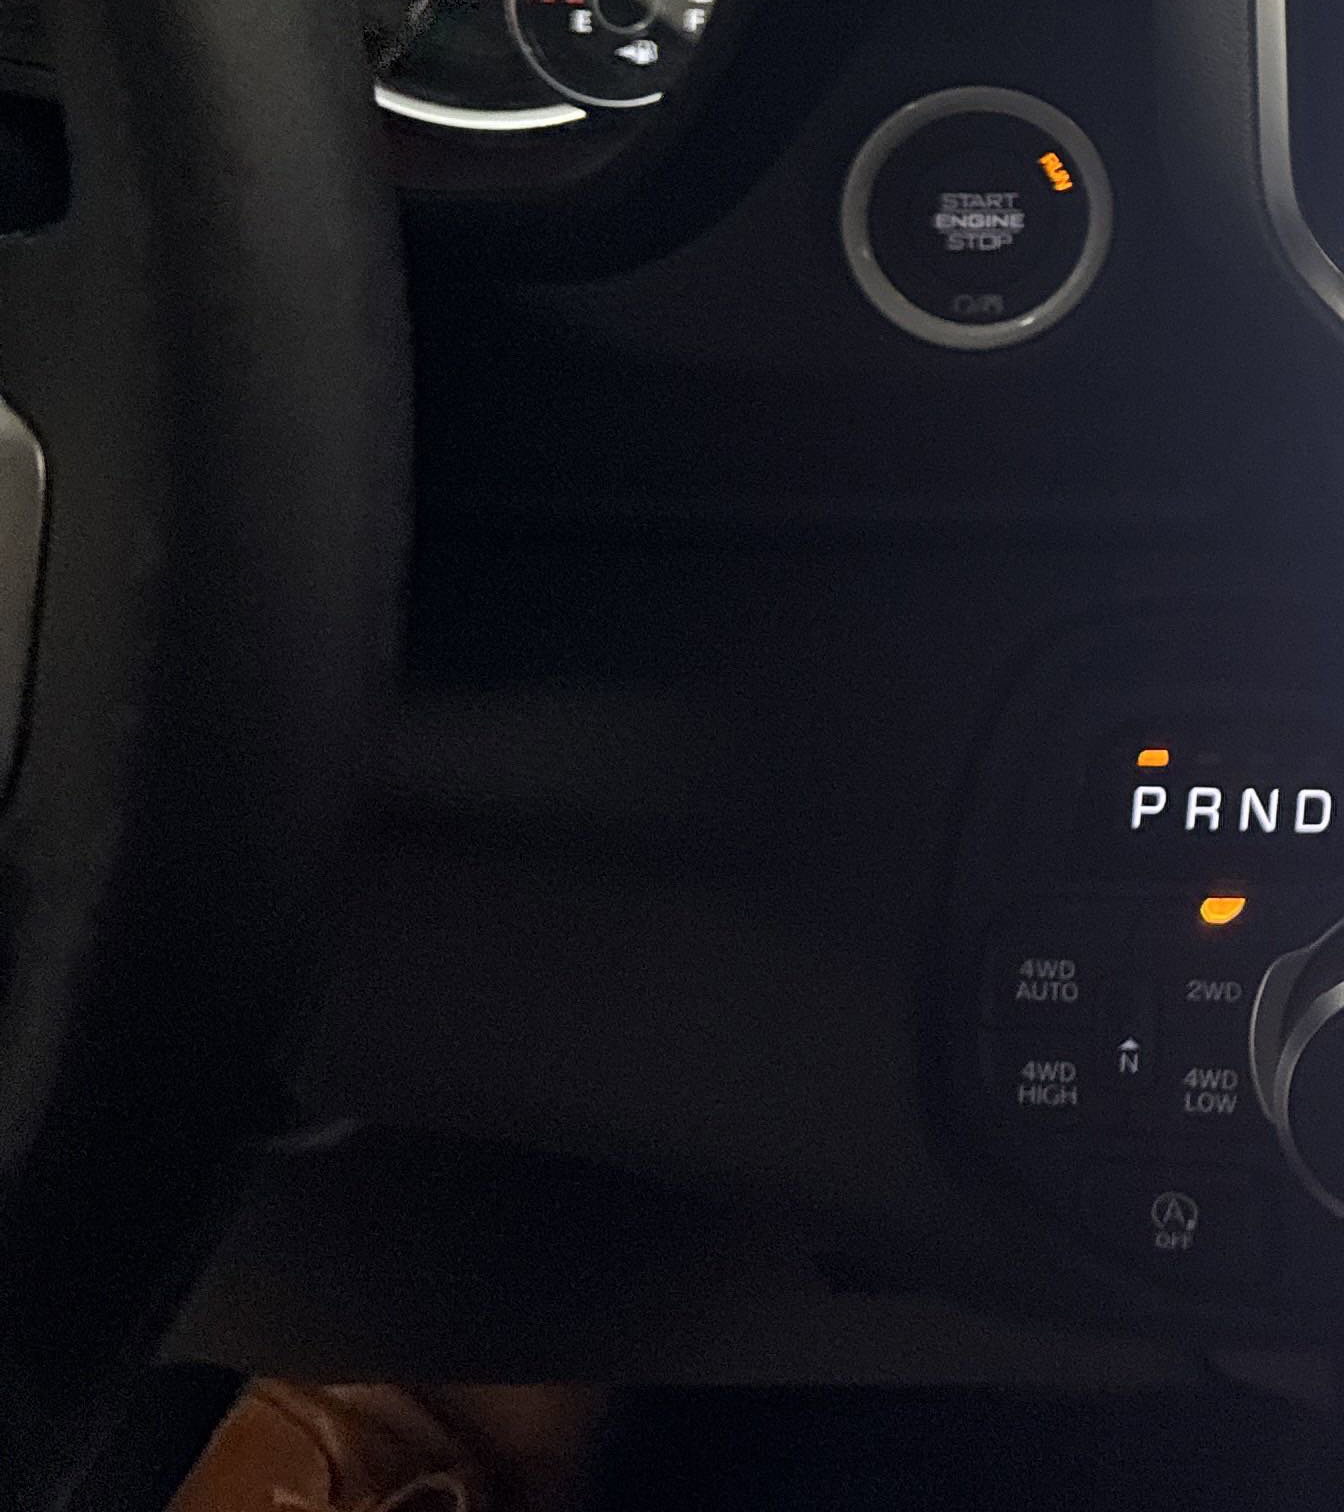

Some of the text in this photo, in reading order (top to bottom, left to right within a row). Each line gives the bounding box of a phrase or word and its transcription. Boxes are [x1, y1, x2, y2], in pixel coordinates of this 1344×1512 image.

[569, 9, 593, 34] E
[683, 8, 705, 33] F
[940, 191, 1019, 209] START
[933, 211, 1025, 230] ENGINE
[945, 233, 1014, 252] STOP
[1018, 958, 1076, 980] 4WD
[1015, 980, 1079, 1002] AUTO
[1186, 980, 1242, 1002] 2WD
[1019, 1061, 1077, 1083] 4WD
[1118, 1053, 1139, 1073] N
[1182, 1067, 1238, 1090] 4WD
[1017, 1084, 1078, 1106] HIGH
[1183, 1091, 1238, 1115] LOW
